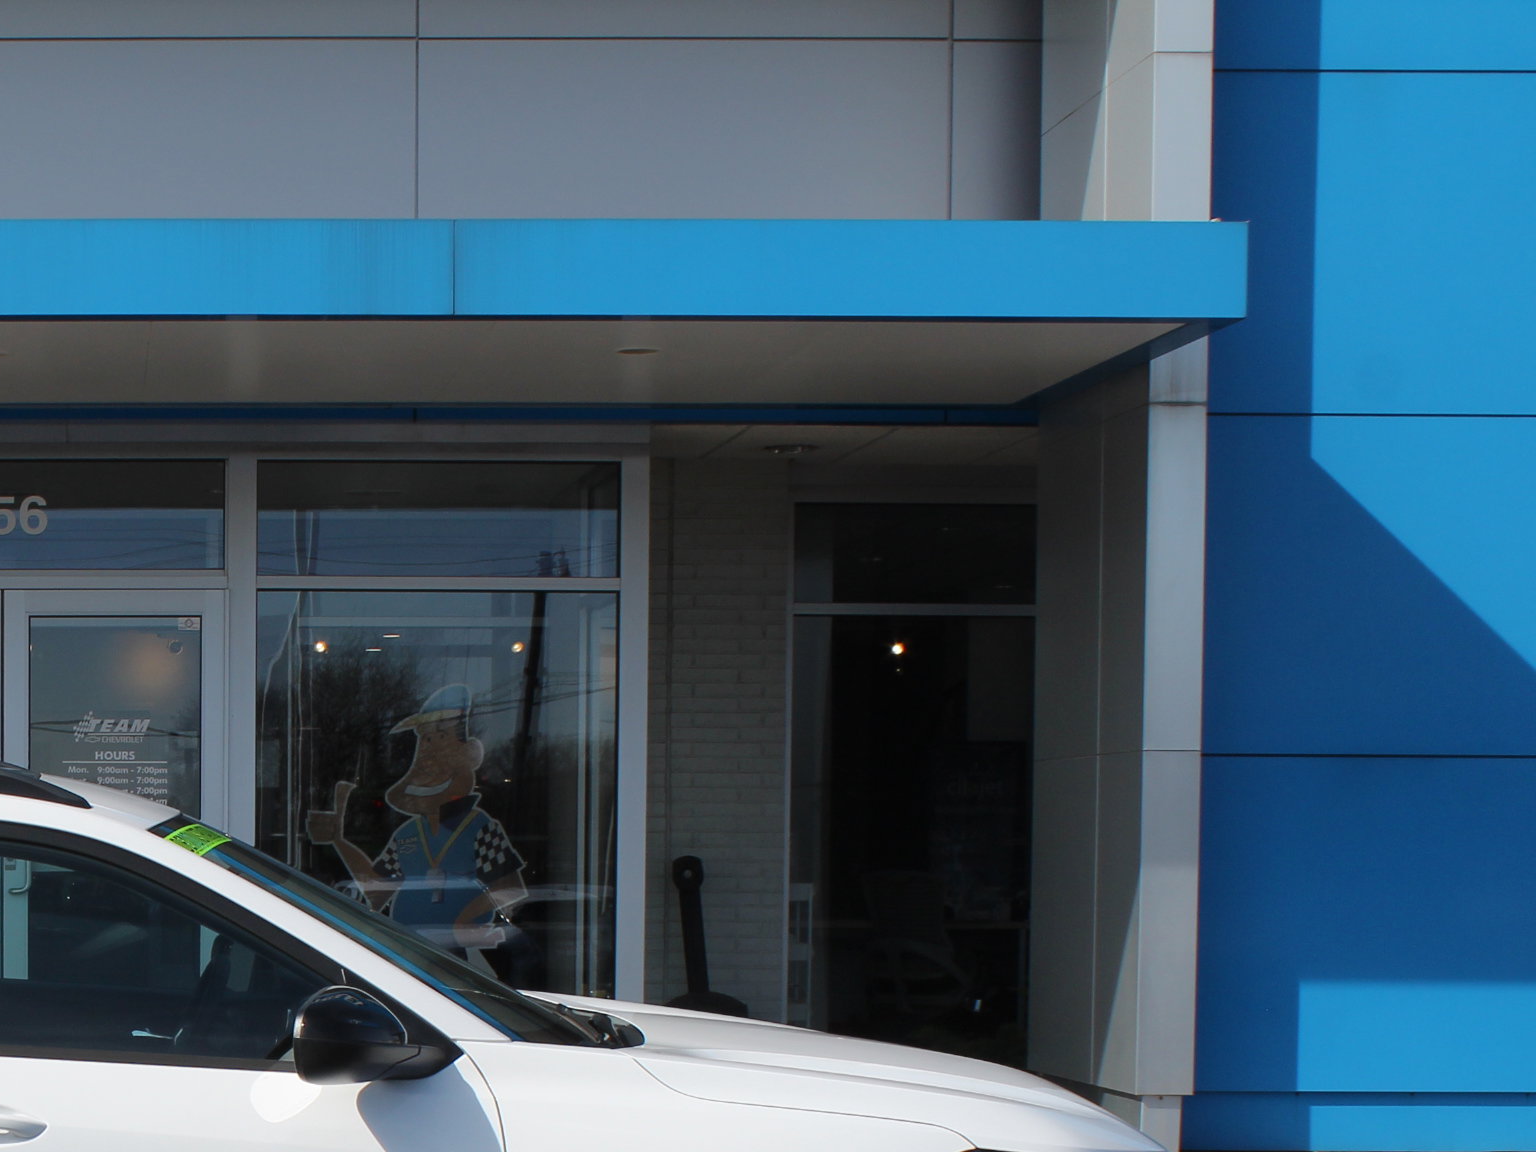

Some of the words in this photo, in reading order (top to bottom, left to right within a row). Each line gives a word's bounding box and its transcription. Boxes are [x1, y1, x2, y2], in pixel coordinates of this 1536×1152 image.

[86, 719, 151, 733] TEAM
[95, 751, 135, 761] HOURS
[68, 766, 89, 774] Mon.
[97, 766, 129, 775] 9:00am
[136, 766, 168, 777] 7:00pm
[97, 777, 129, 785] 9:00am
[136, 777, 168, 787] 7:00pm
[136, 787, 168, 796] 7:00pm
